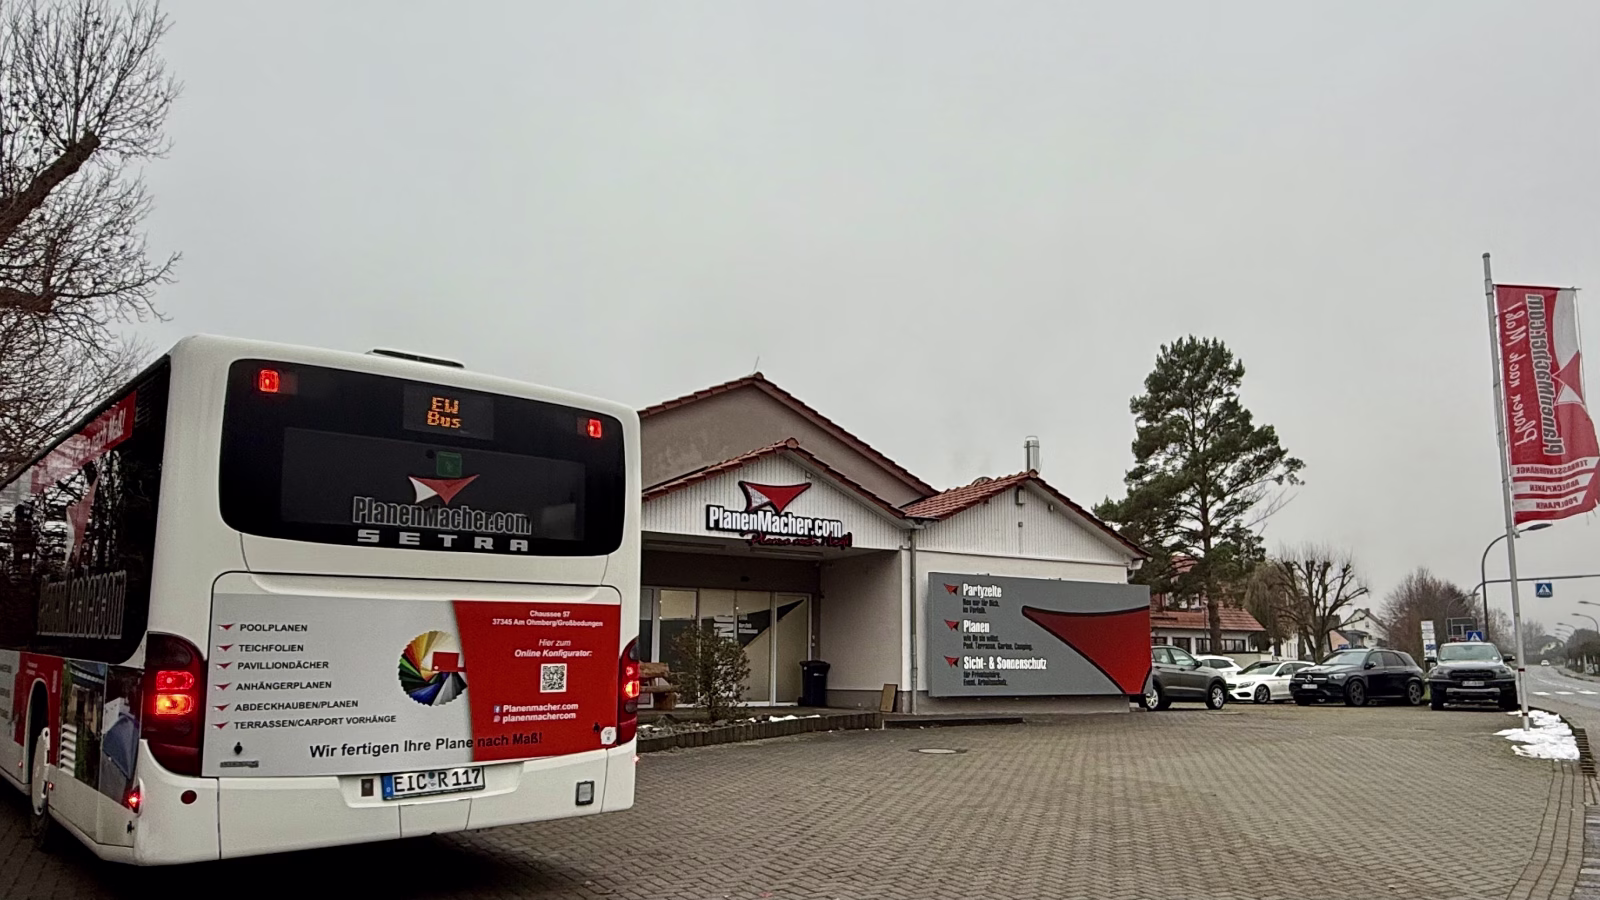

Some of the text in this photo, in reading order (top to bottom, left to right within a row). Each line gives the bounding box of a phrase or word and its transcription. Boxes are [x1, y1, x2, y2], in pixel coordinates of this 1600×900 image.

[431, 397, 459, 414] EW
[427, 411, 461, 428] Bus
[352, 496, 532, 535] PlanenMacher.com
[708, 505, 843, 538] PlanenMacher.com
[357, 529, 529, 551] SETRA
[963, 583, 1002, 598] Partyzelte
[239, 623, 308, 632] POOLPLANEN
[963, 620, 990, 632] Planen
[239, 644, 304, 652] TEICHFOLIEN
[538, 639, 555, 647] Hier
[514, 649, 593, 658] Online Konfigurator:
[237, 661, 329, 670] PAVILLIONDÄCHER
[963, 656, 1047, 669] Sicht- & Sonnenschutz
[236, 681, 332, 691] ANHÄNGERPLANEN
[234, 700, 359, 712] ABDECKHAUBEN/PLANEN
[503, 703, 579, 713] Planenmacher.com
[234, 715, 397, 730] TERRASSEN/CARPORT VORHÄNGE
[309, 732, 542, 758] Wir fertigen Ihre Plane nach Maß!
[393, 773, 427, 793] EIC
[438, 771, 449, 788] R
[451, 769, 482, 786] 117
